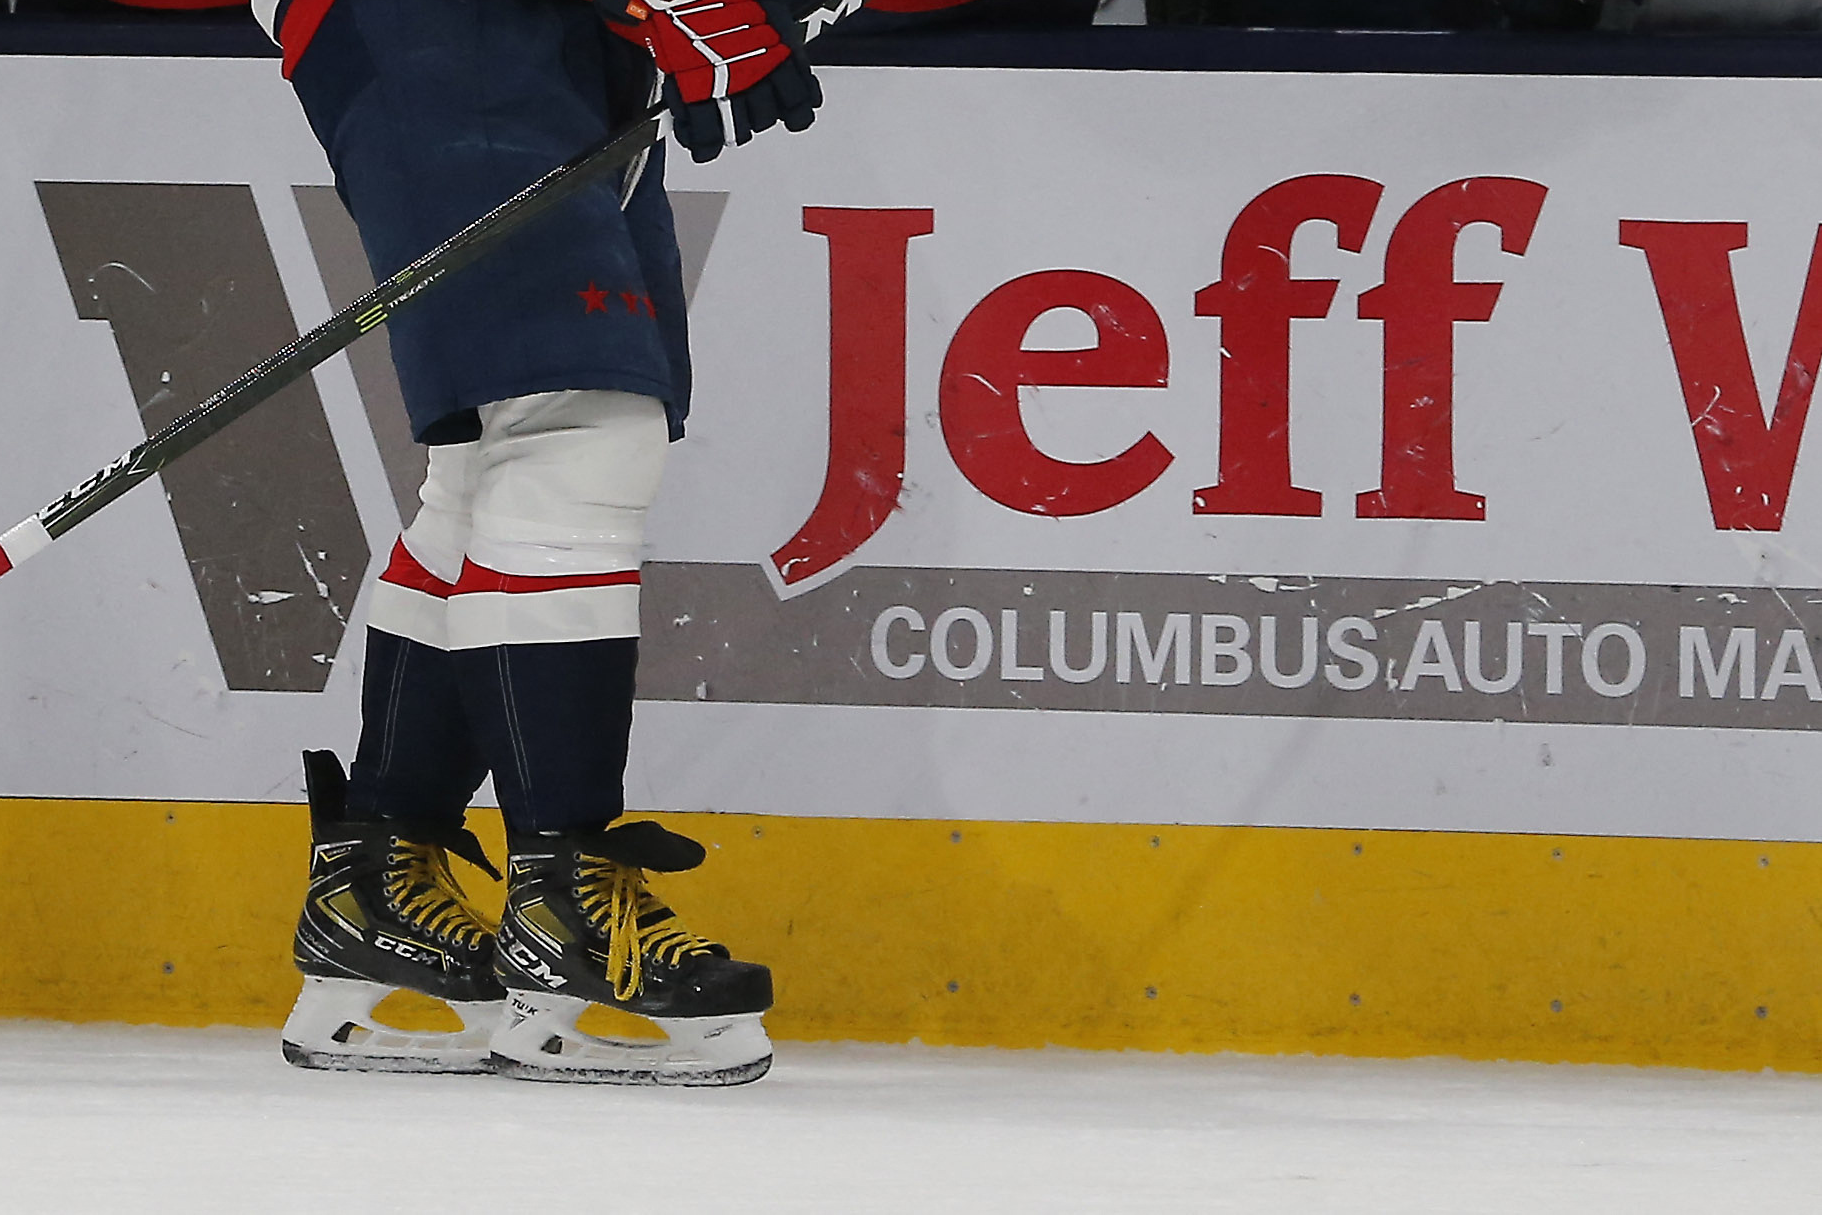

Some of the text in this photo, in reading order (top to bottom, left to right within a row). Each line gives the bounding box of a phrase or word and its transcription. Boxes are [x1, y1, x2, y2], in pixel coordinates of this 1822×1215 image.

[770, 173, 1549, 586] Jeff
[38, 449, 133, 521] CCM
[870, 605, 1822, 704] COLUMBUS AUTO MA
[375, 935, 448, 965] CCM
